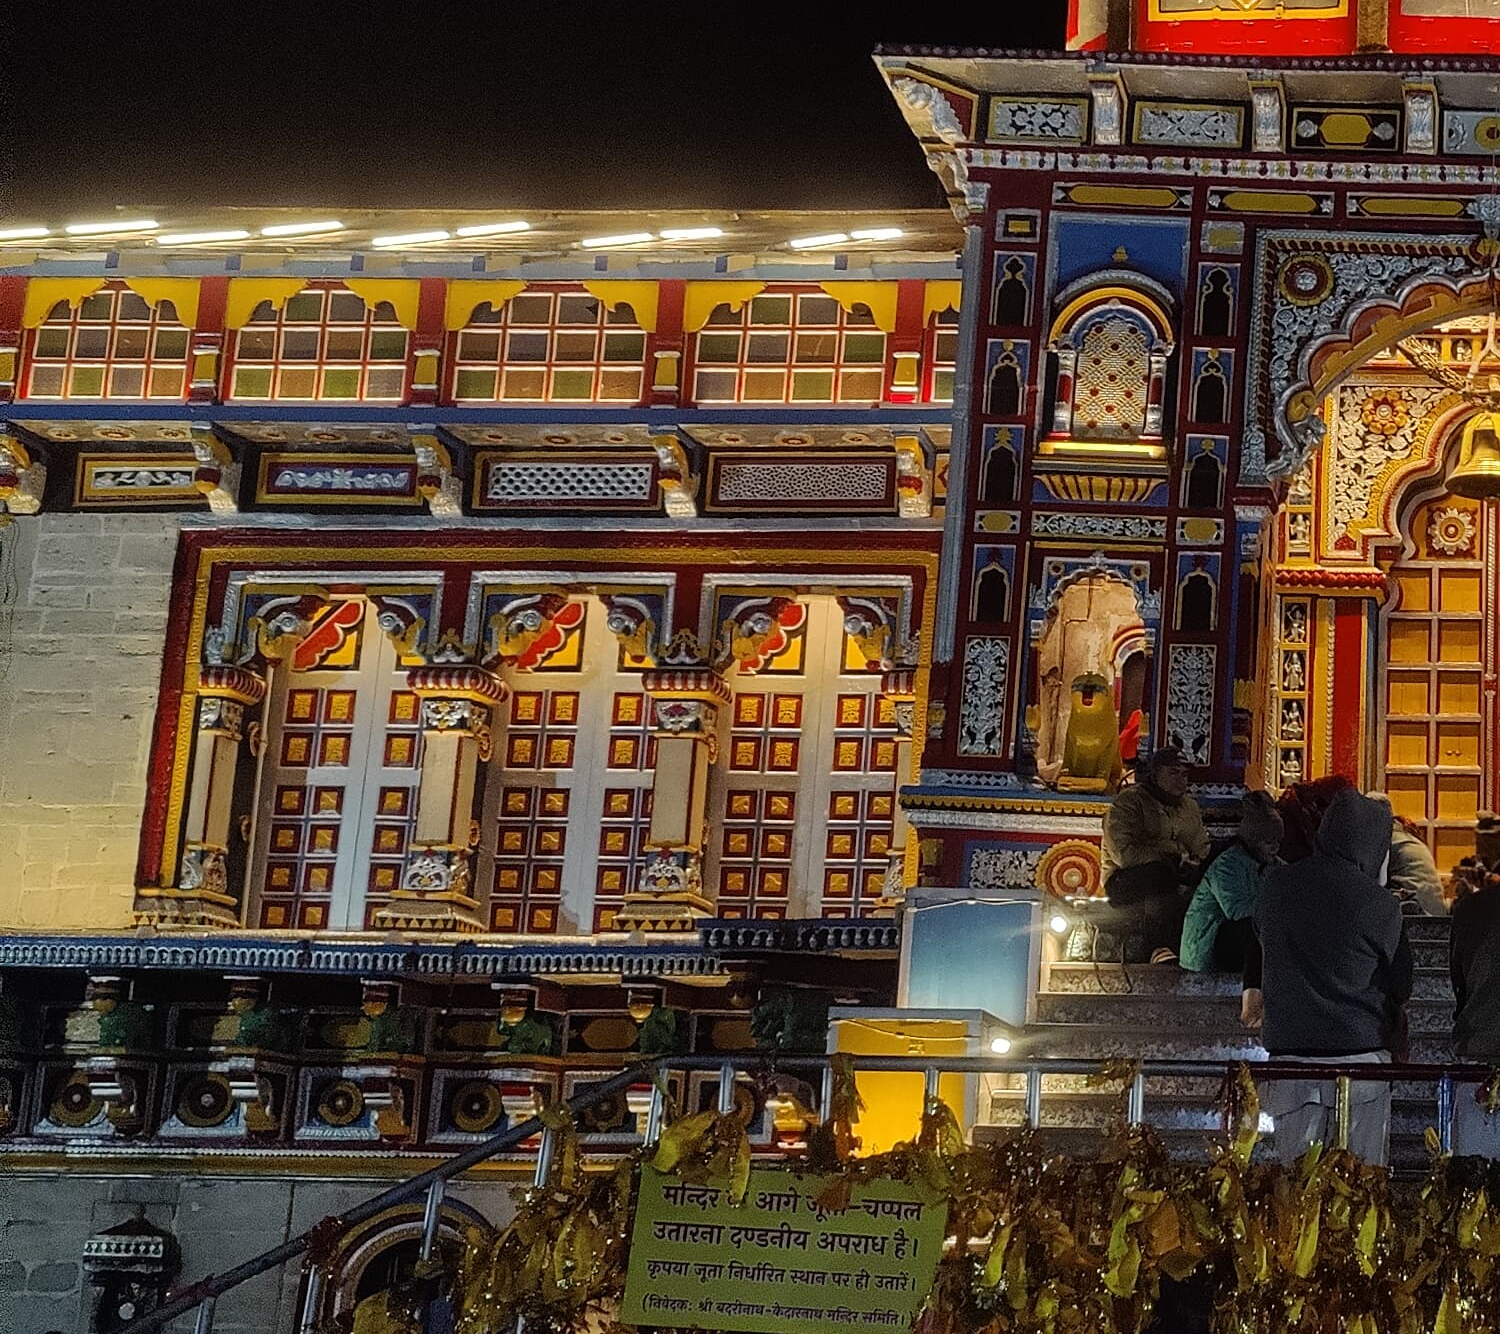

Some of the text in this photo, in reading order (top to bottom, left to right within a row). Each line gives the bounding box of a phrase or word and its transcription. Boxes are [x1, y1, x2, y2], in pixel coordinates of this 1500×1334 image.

[755, 1186, 801, 1213] आगे
[653, 1221, 725, 1244] उतारना
[729, 1221, 811, 1250] दण्डनीय
[817, 1232, 889, 1256] अपराध
[647, 1260, 690, 1279] कृपया
[694, 1263, 725, 1283] जूता
[727, 1260, 786, 1283] निर्धारित
[790, 1269, 828, 1285] स्थान
[831, 1272, 852, 1287] पर
[855, 1268, 871, 1290] ही
[698, 1298, 713, 1312] श्री
